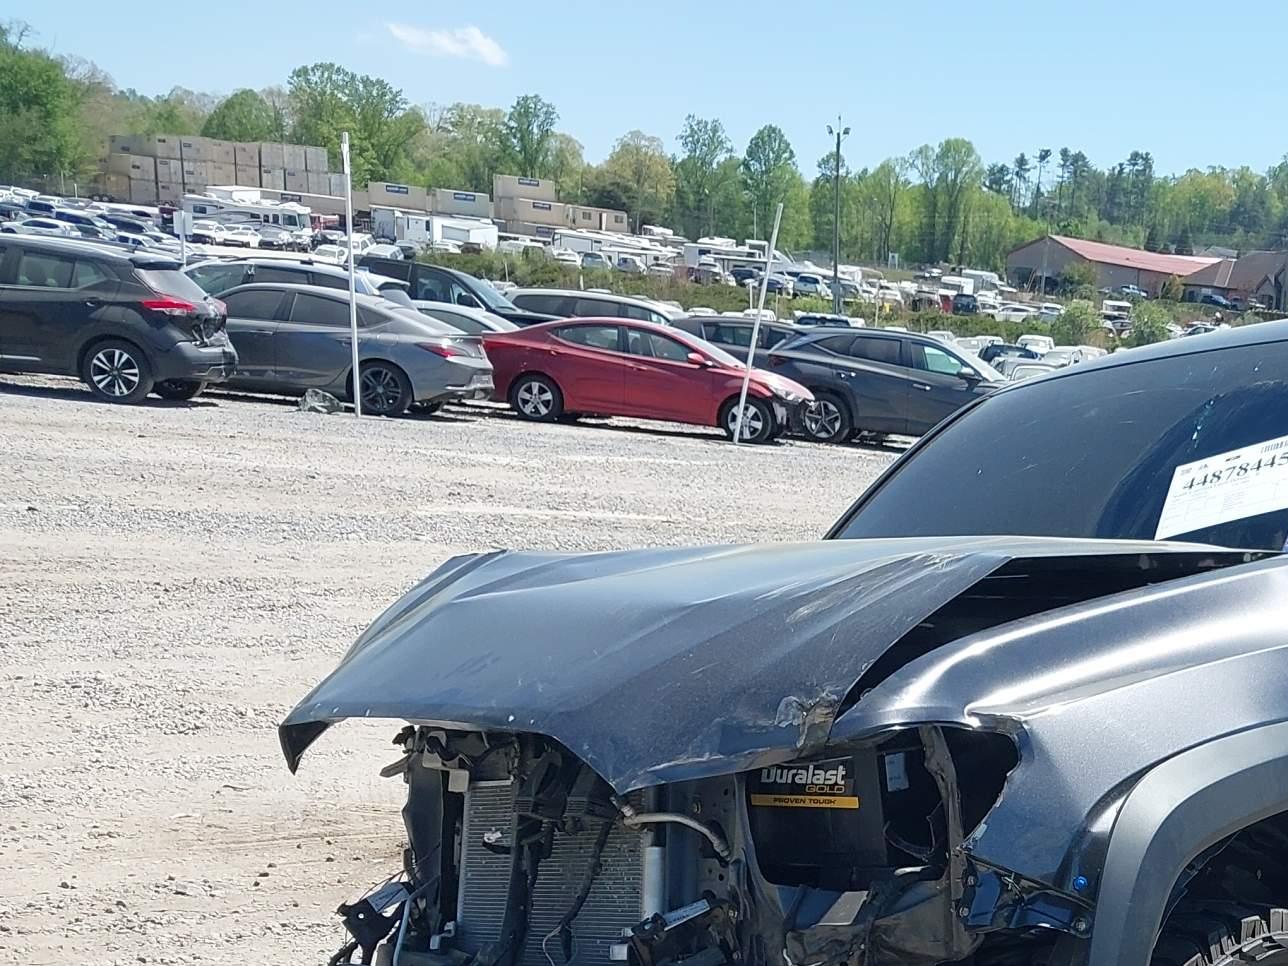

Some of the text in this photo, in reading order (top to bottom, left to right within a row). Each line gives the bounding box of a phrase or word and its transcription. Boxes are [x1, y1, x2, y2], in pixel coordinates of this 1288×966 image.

[760, 764, 847, 785] Duralast
[805, 784, 846, 794] GOLD
[773, 797, 837, 805] PROVEN TOUGH
